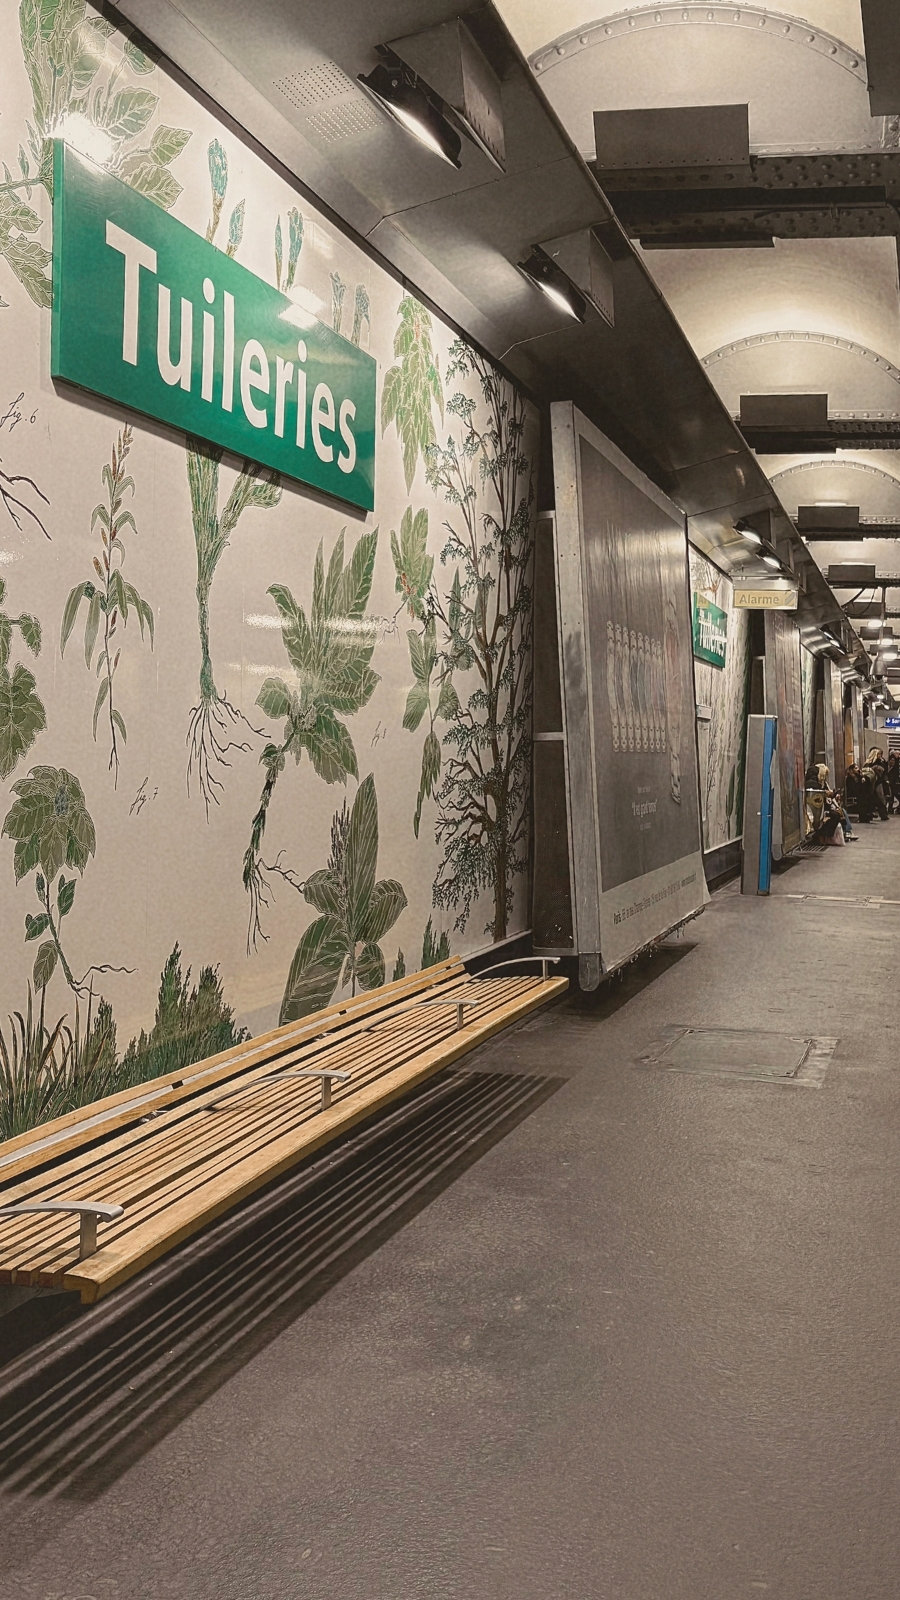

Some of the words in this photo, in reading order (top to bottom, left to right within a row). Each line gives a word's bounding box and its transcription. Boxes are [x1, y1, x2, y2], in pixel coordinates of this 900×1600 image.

[105, 219, 357, 474] Tuileries
[29, 408, 39, 424] 6
[739, 594, 780, 605] Alarme
